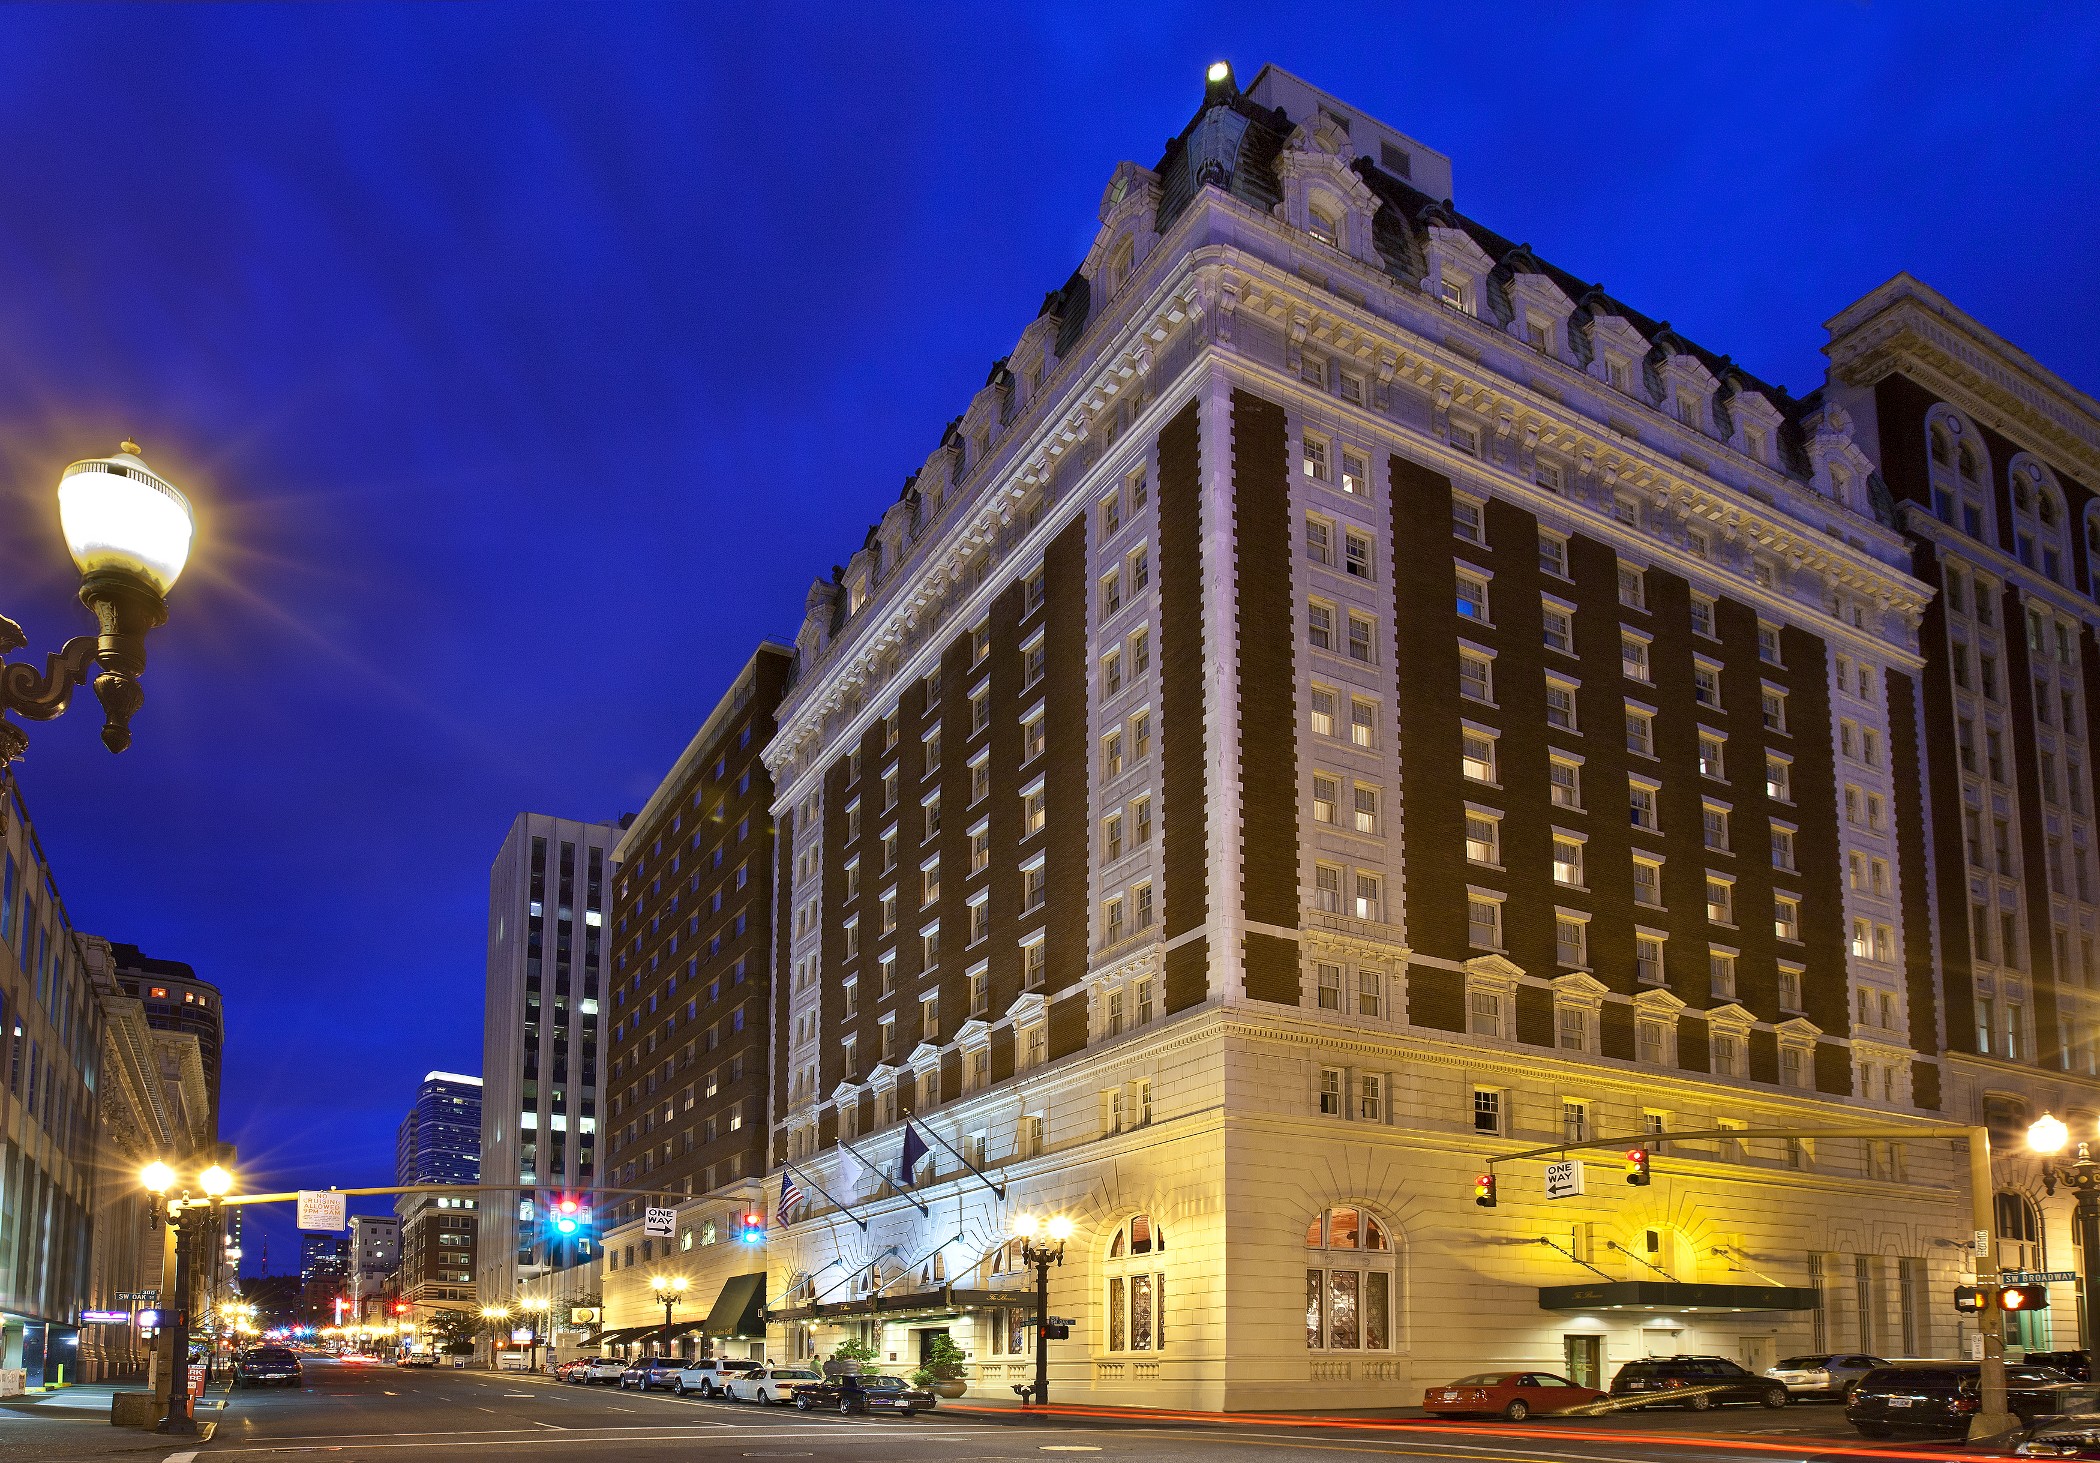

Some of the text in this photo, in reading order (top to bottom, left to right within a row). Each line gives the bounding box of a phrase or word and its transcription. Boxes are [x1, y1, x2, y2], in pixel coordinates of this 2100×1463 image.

[1548, 1163, 1572, 1174] ONE
[1548, 1172, 1572, 1183] WAY
[303, 1197, 341, 1205] CRUISING
[648, 1209, 673, 1217] ONE
[648, 1216, 673, 1224] WAY
[2005, 1272, 2074, 1283] SW BROADWAY
